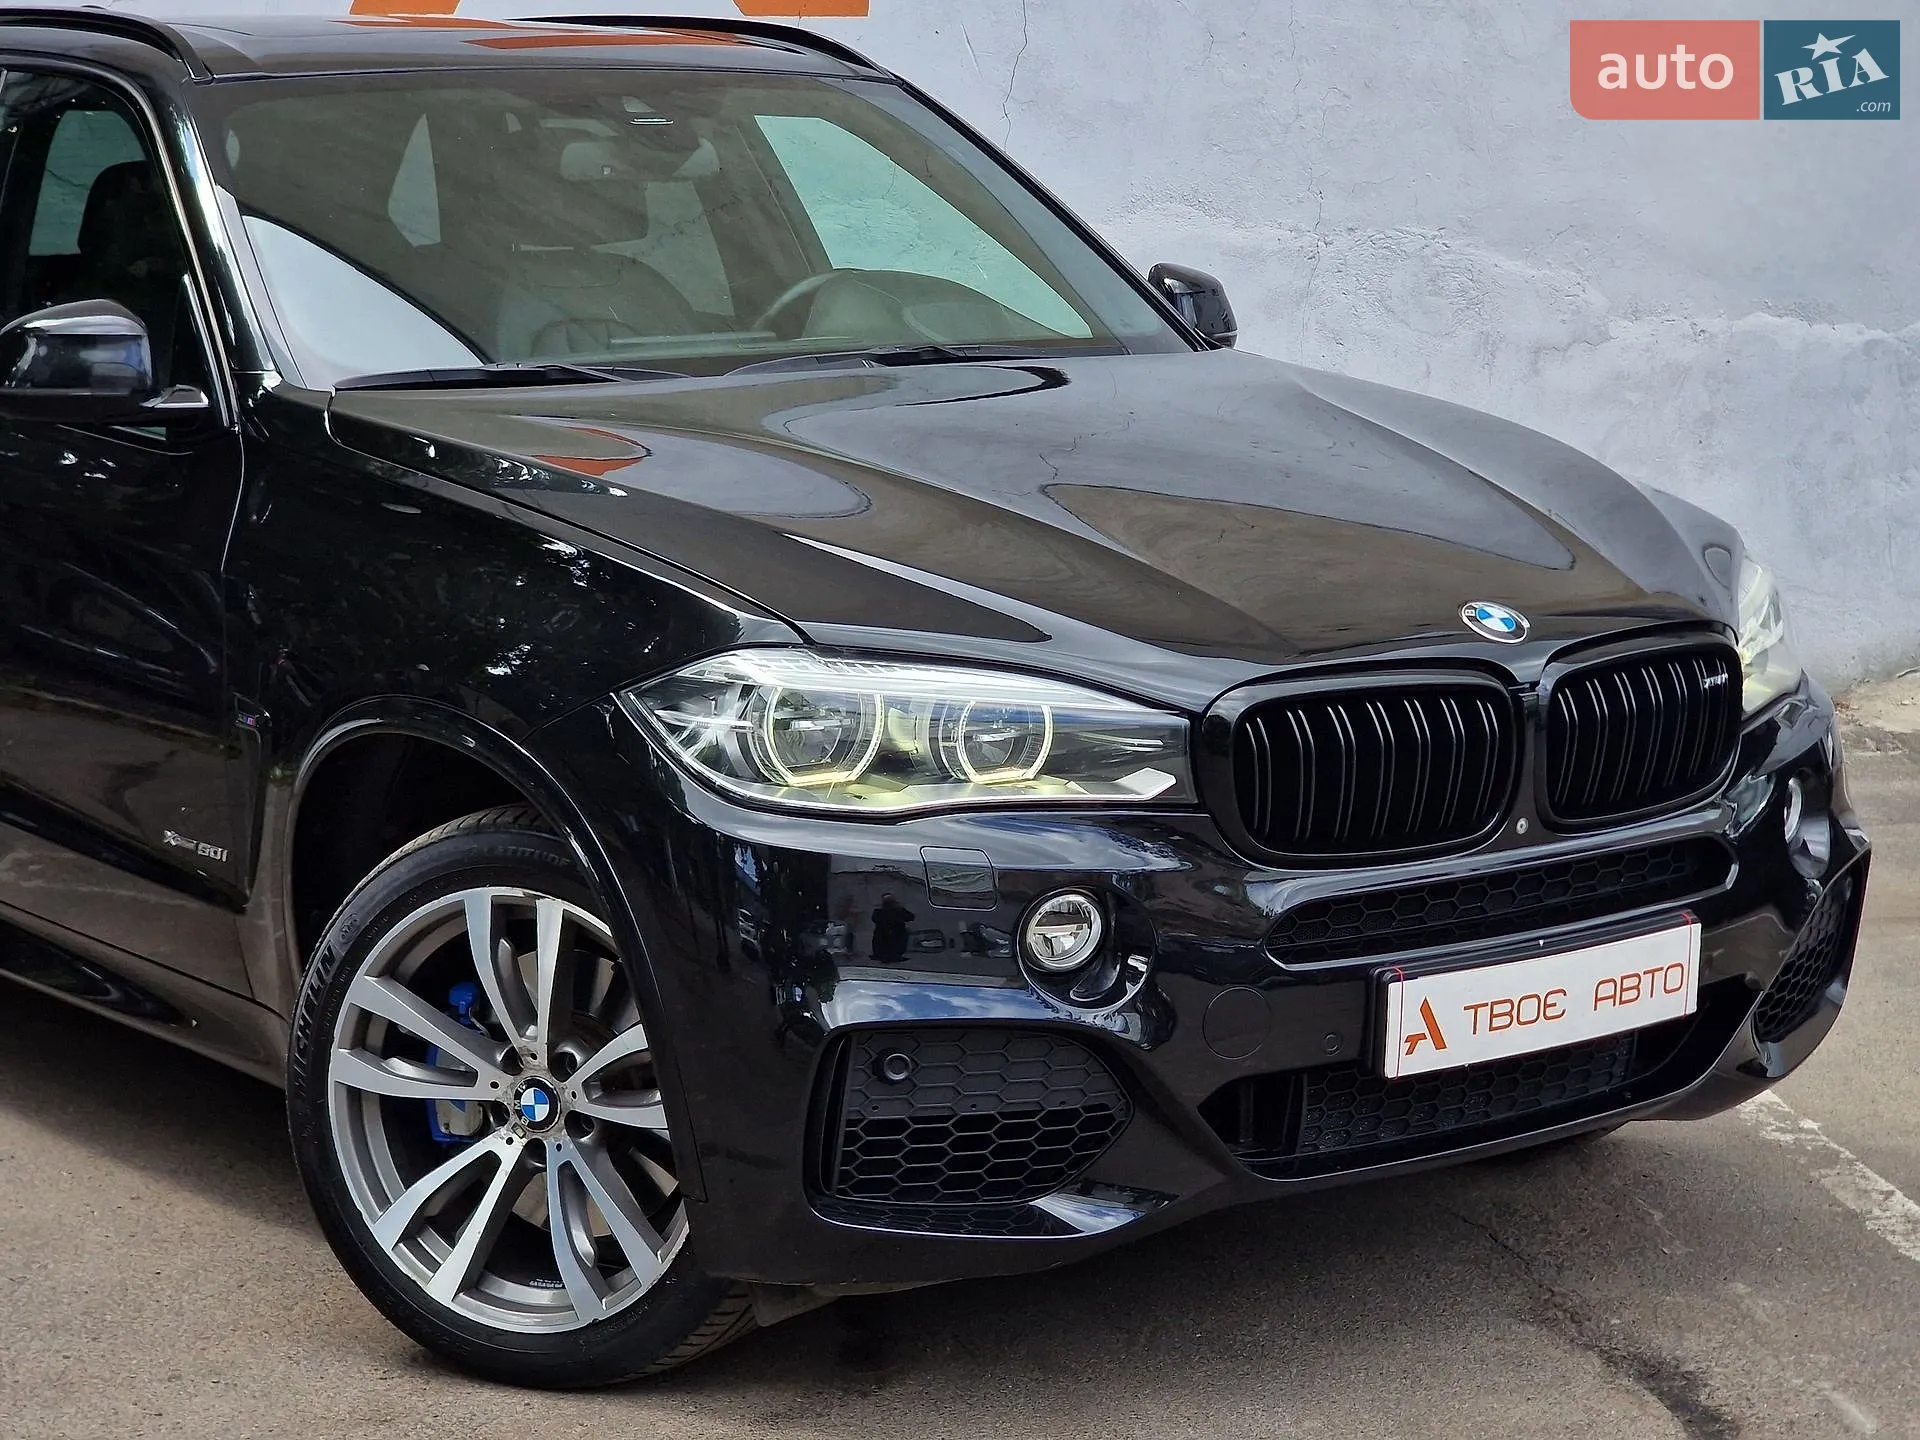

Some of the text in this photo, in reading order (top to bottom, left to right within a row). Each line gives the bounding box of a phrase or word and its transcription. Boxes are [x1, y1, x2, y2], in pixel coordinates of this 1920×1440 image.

[293, 942, 337, 1098] MICHELIN
[1463, 988, 1568, 1035] ТВОЄ
[1592, 961, 1685, 1012] АВТО
